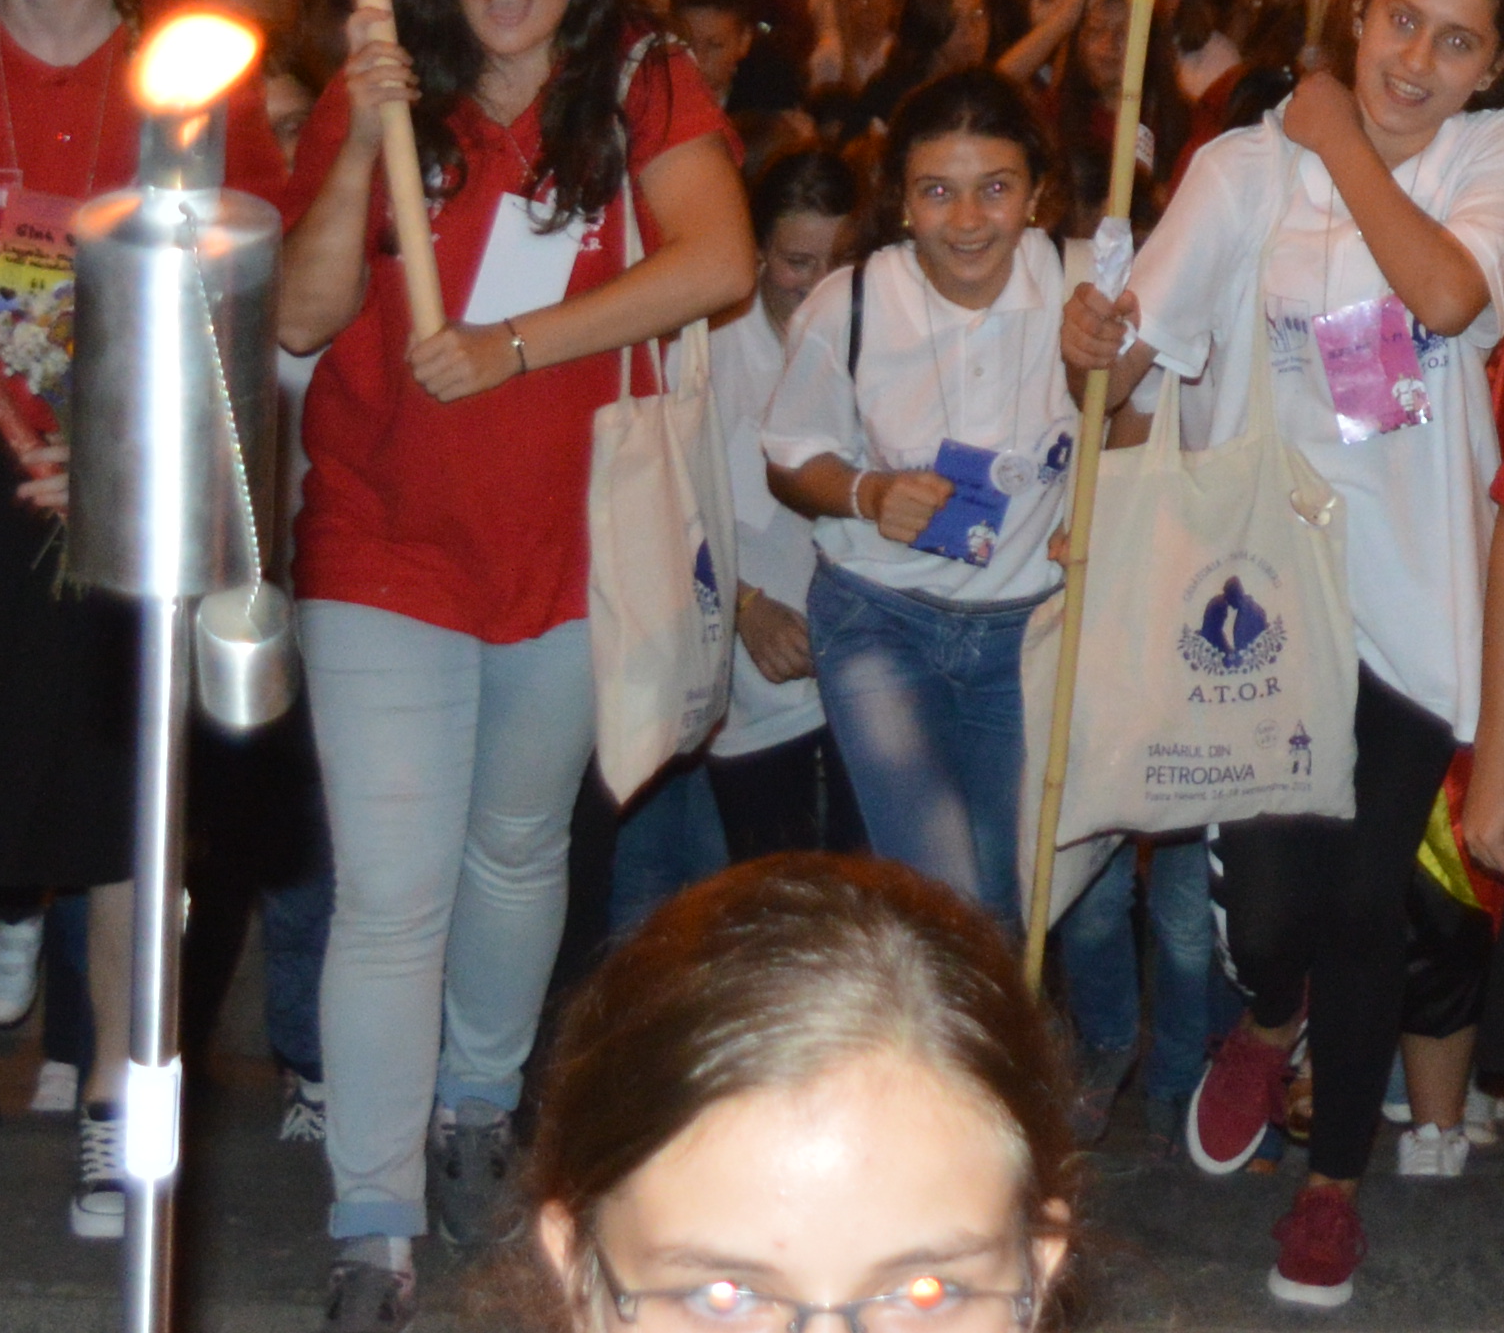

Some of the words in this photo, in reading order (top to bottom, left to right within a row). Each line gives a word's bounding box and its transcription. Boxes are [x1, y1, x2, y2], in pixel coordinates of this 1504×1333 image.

[1188, 676, 1282, 704] A.T.O.R
[1208, 744, 1232, 758] DIN
[1145, 763, 1256, 785] PETRODAVA
